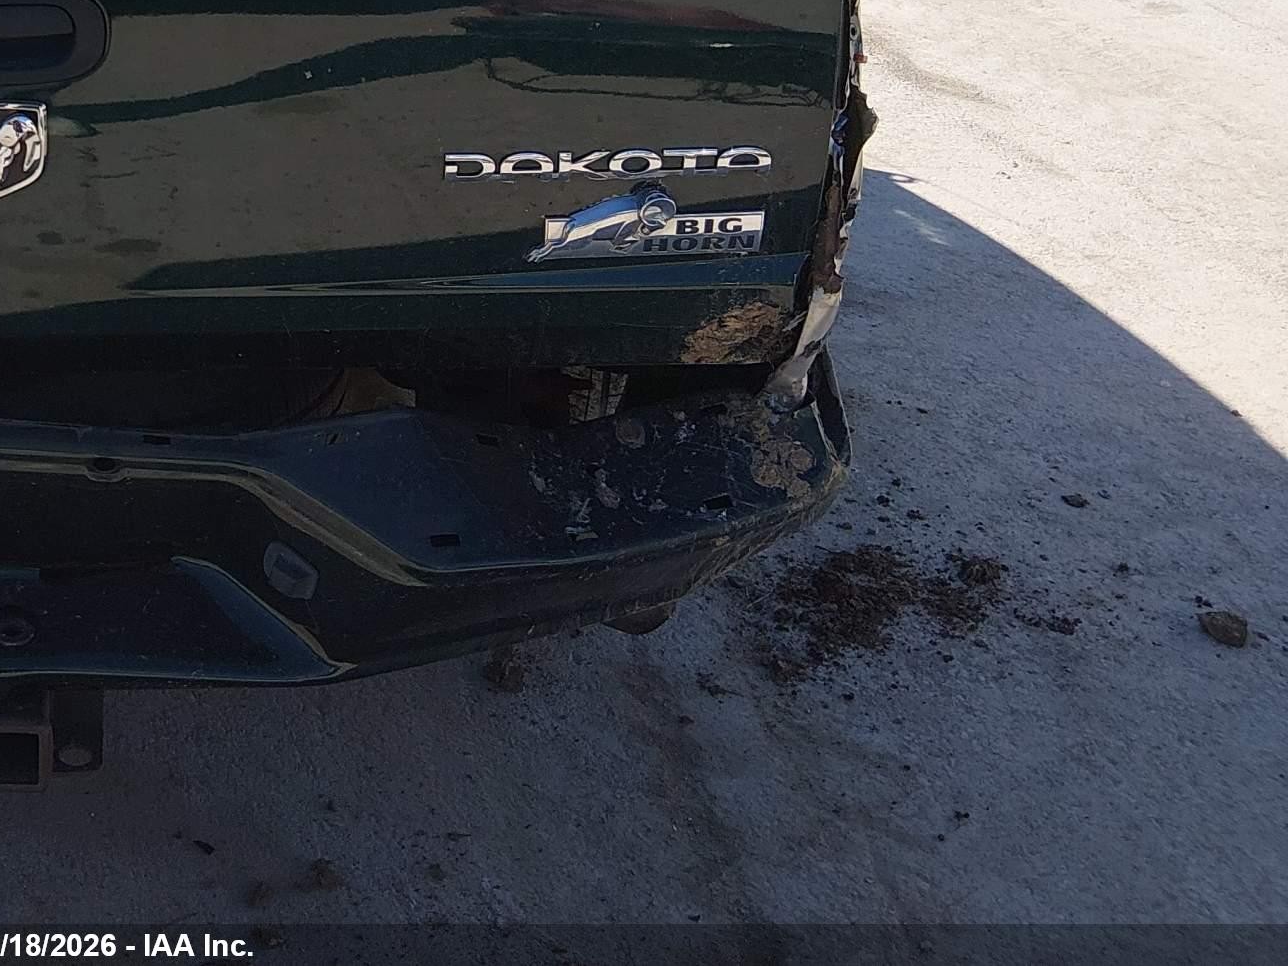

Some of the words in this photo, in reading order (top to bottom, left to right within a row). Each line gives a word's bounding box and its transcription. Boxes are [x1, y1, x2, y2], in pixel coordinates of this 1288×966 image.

[444, 146, 772, 180] DAKOTA
[676, 217, 743, 234] BIG
[642, 234, 756, 252] HORN
